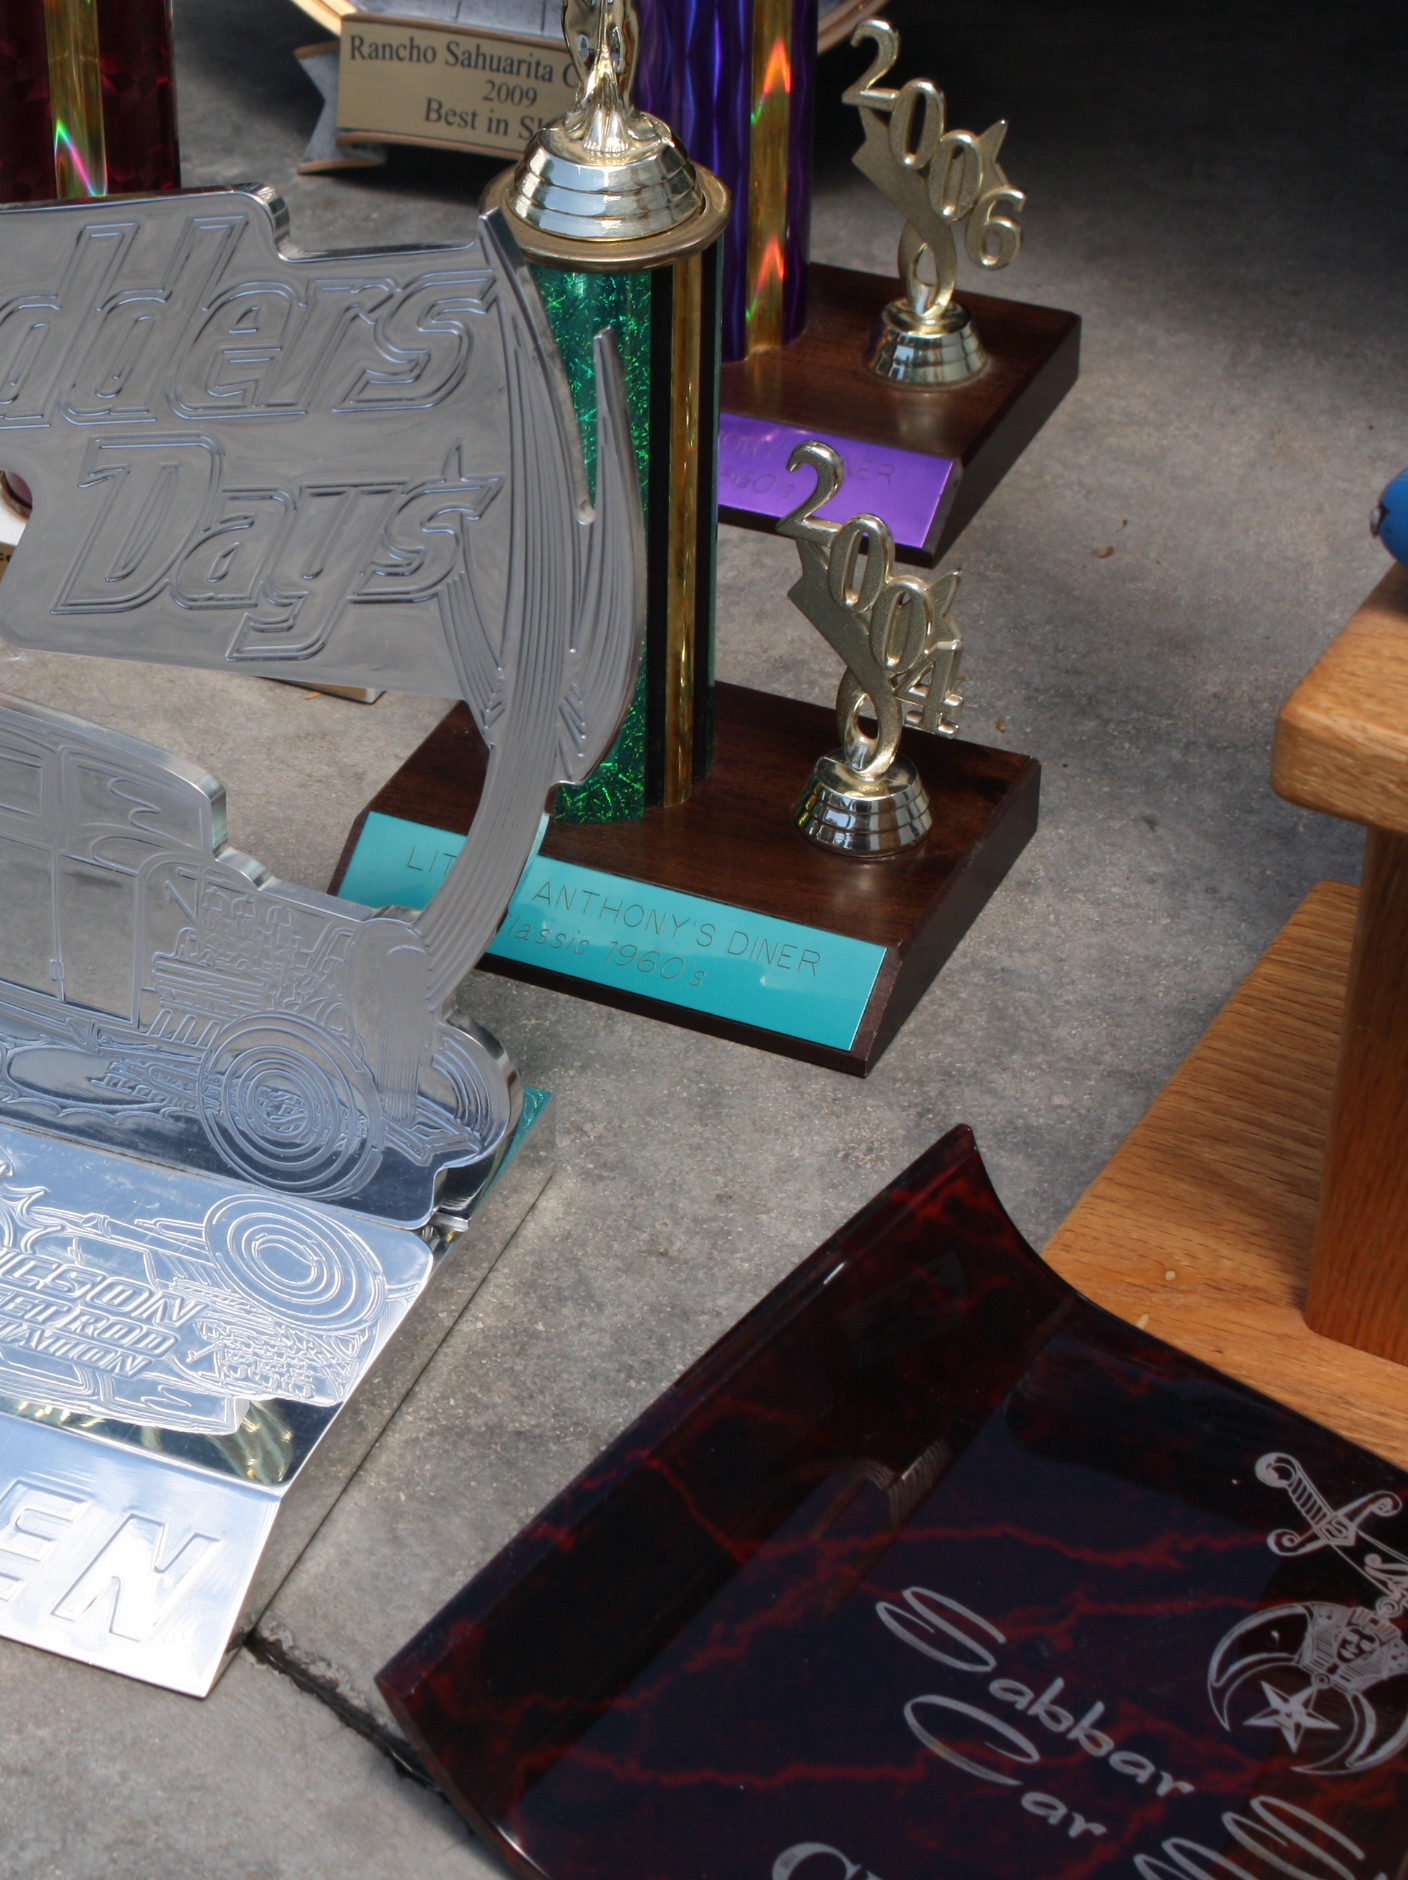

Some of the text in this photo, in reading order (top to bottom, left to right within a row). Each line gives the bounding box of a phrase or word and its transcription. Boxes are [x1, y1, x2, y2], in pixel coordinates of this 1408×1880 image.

[349, 35, 437, 64] Rancho
[444, 40, 554, 83] Sahuarita
[482, 79, 538, 109] 2009
[424, 98, 478, 130] Best
[486, 108, 510, 136] in
[841, 18, 1028, 271] 2006
[48, 431, 505, 662] Days
[775, 440, 964, 739] 2004
[406, 845, 823, 978] LIT ANTHONY'S DINER
[499, 911, 707, 988] lassic 1960's
